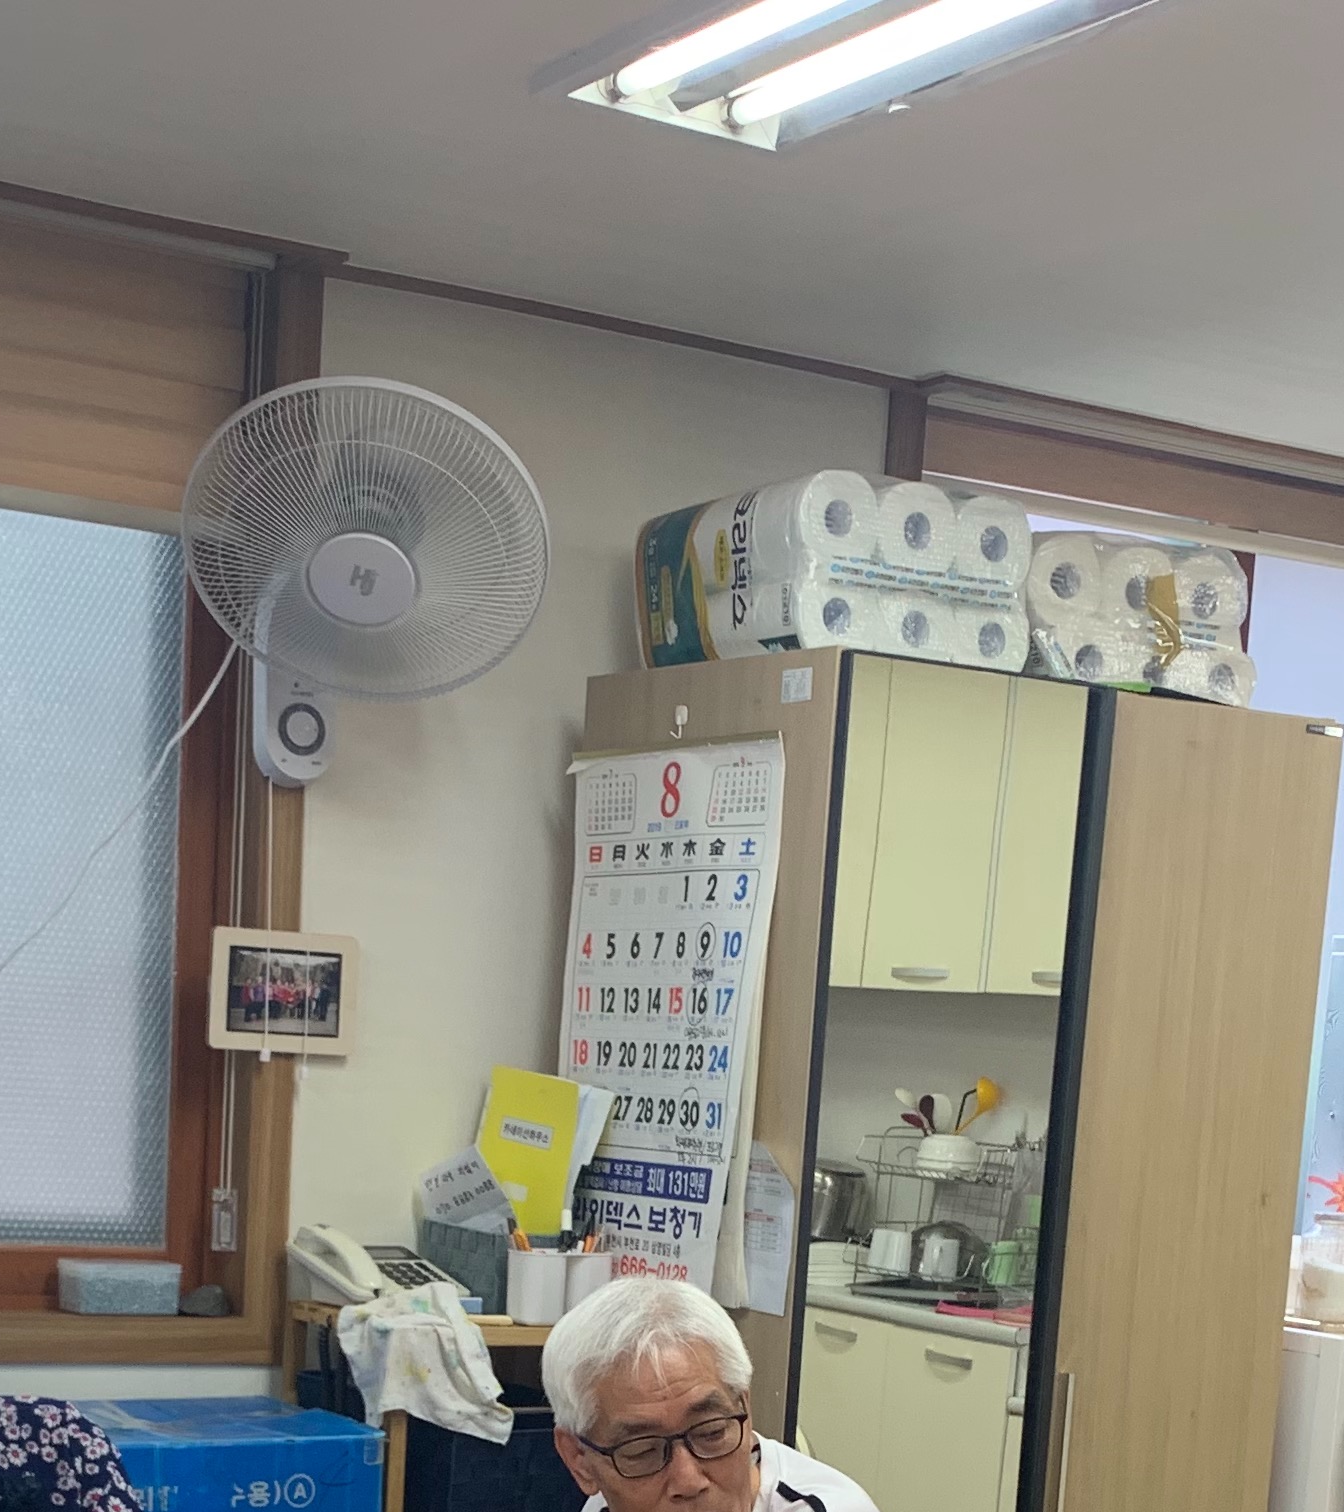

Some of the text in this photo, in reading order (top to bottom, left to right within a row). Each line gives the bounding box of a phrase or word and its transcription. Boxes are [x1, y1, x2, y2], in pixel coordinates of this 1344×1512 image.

[660, 761, 682, 818] 8
[589, 837, 756, 863] 日 月 火 水 木 金 土
[683, 875, 689, 902] 1
[705, 874, 718, 901] 2
[733, 874, 749, 901] 3
[582, 930, 742, 959] 4 5 6 7 8 9 10
[577, 986, 734, 1016] 11 12 13 14 15 16 17
[573, 1039, 729, 1073] 18 19 20 21 22 23 24
[613, 1095, 722, 1130] 27 28 29 30 31
[647, 1206, 702, 1240] 보청기
